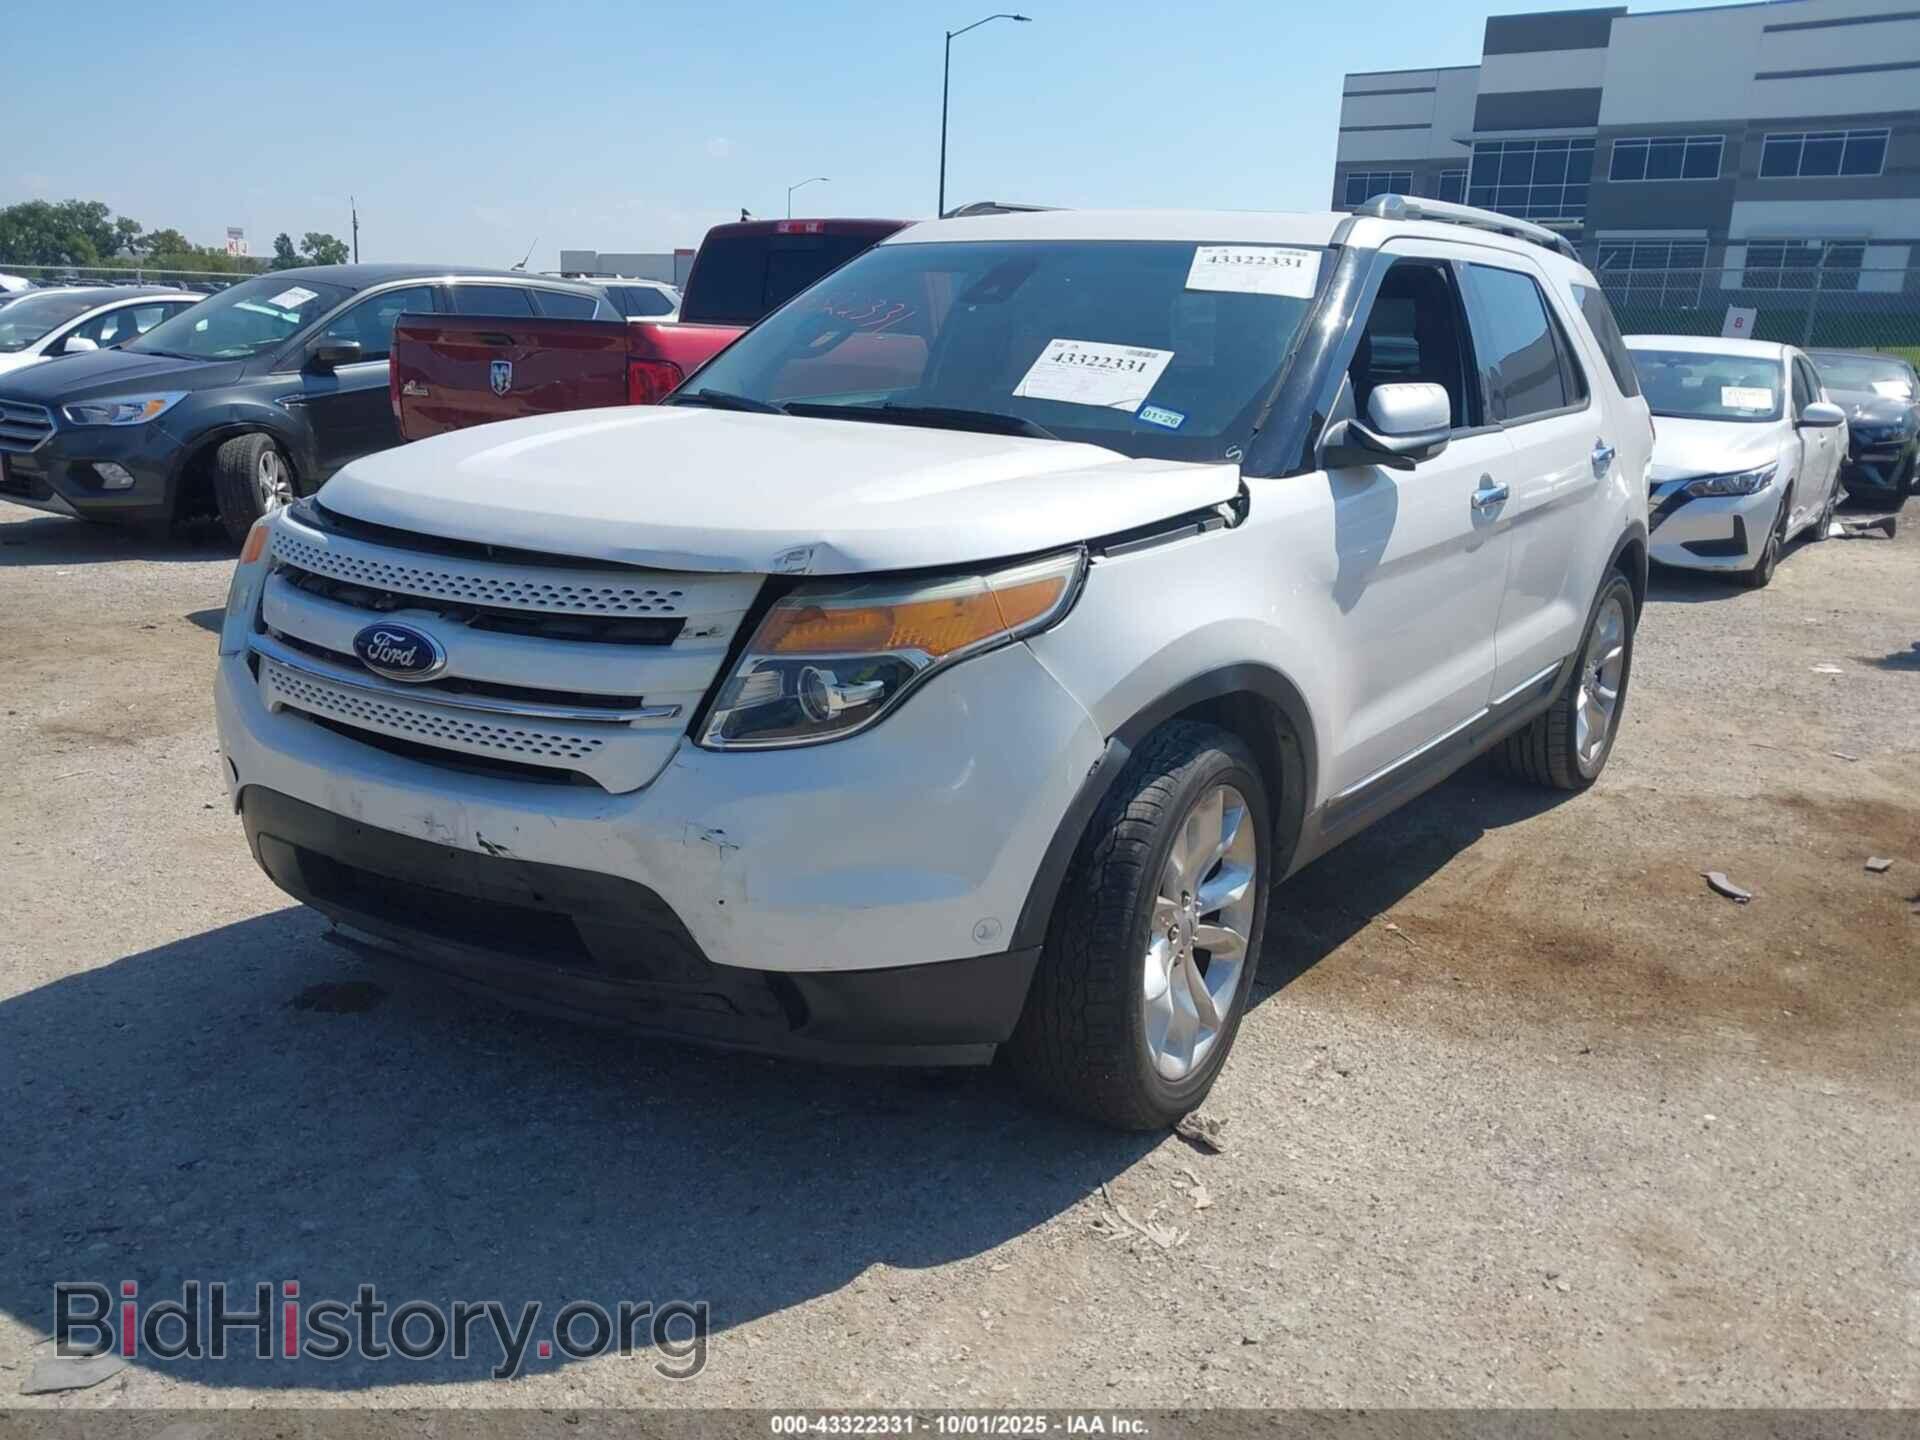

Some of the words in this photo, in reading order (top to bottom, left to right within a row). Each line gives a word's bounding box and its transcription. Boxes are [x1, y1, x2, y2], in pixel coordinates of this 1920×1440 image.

[1207, 255, 1302, 268] 43322331
[1051, 352, 1147, 373] 43322331
[367, 631, 417, 667] Ford
